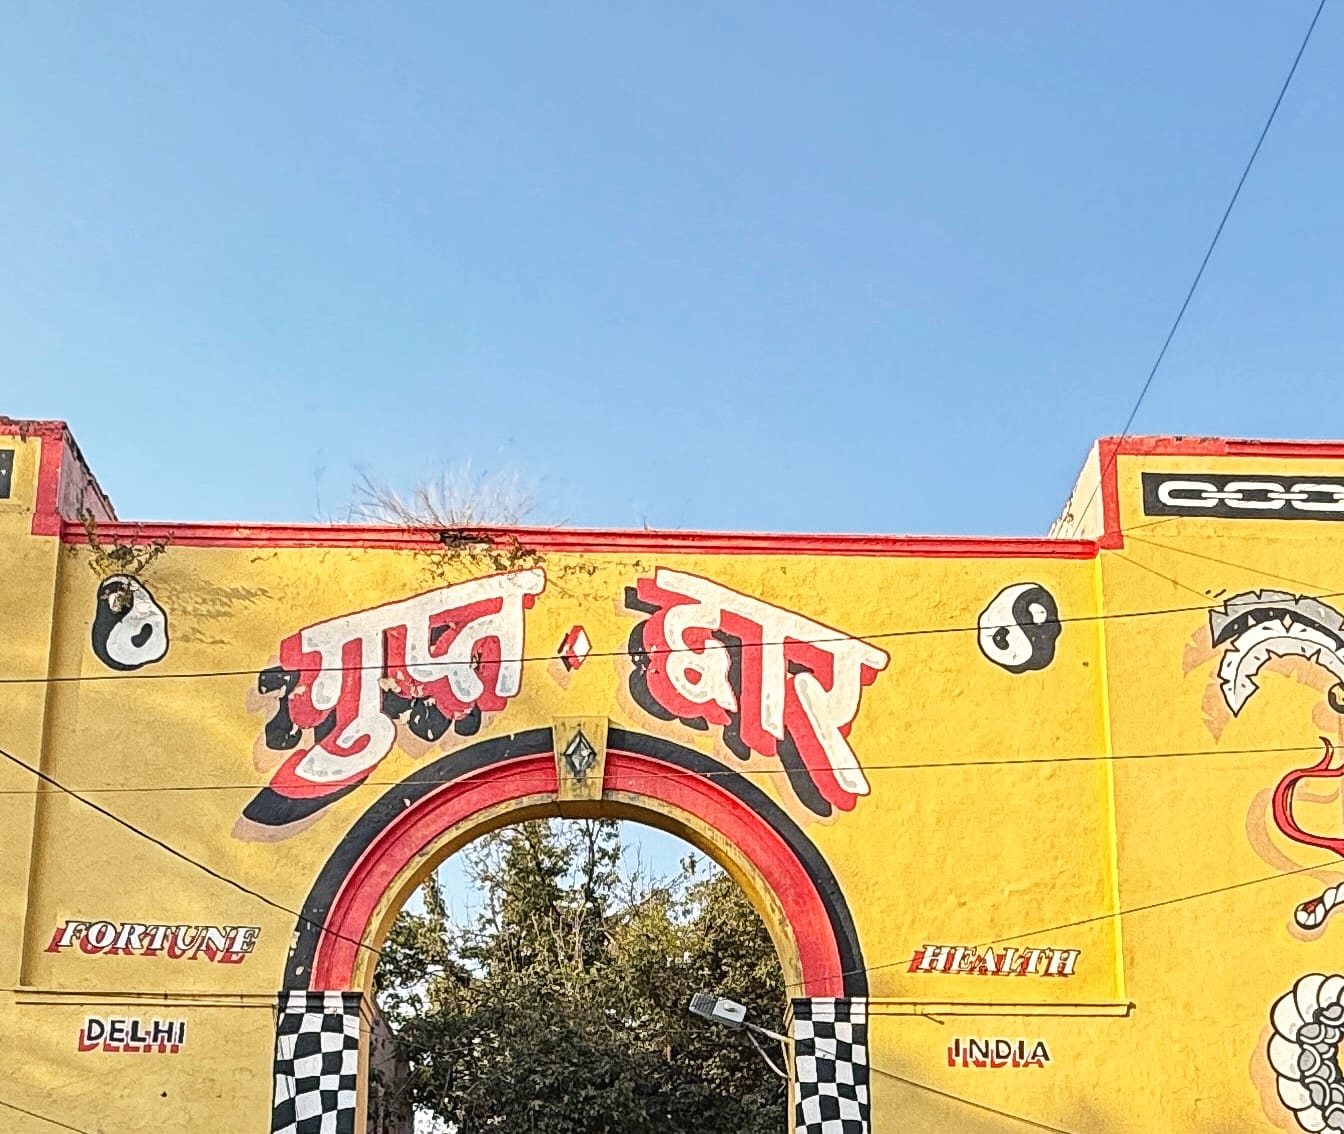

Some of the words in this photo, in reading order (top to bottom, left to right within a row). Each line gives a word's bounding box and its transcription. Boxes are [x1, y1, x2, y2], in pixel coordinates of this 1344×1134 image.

[288, 566, 548, 790] गुप्त
[646, 564, 891, 800] द्वार
[50, 920, 262, 960] FORTUNE
[913, 944, 1081, 977] HEALTH
[81, 1018, 186, 1050] DELHI
[950, 1037, 1051, 1066] INDIA
